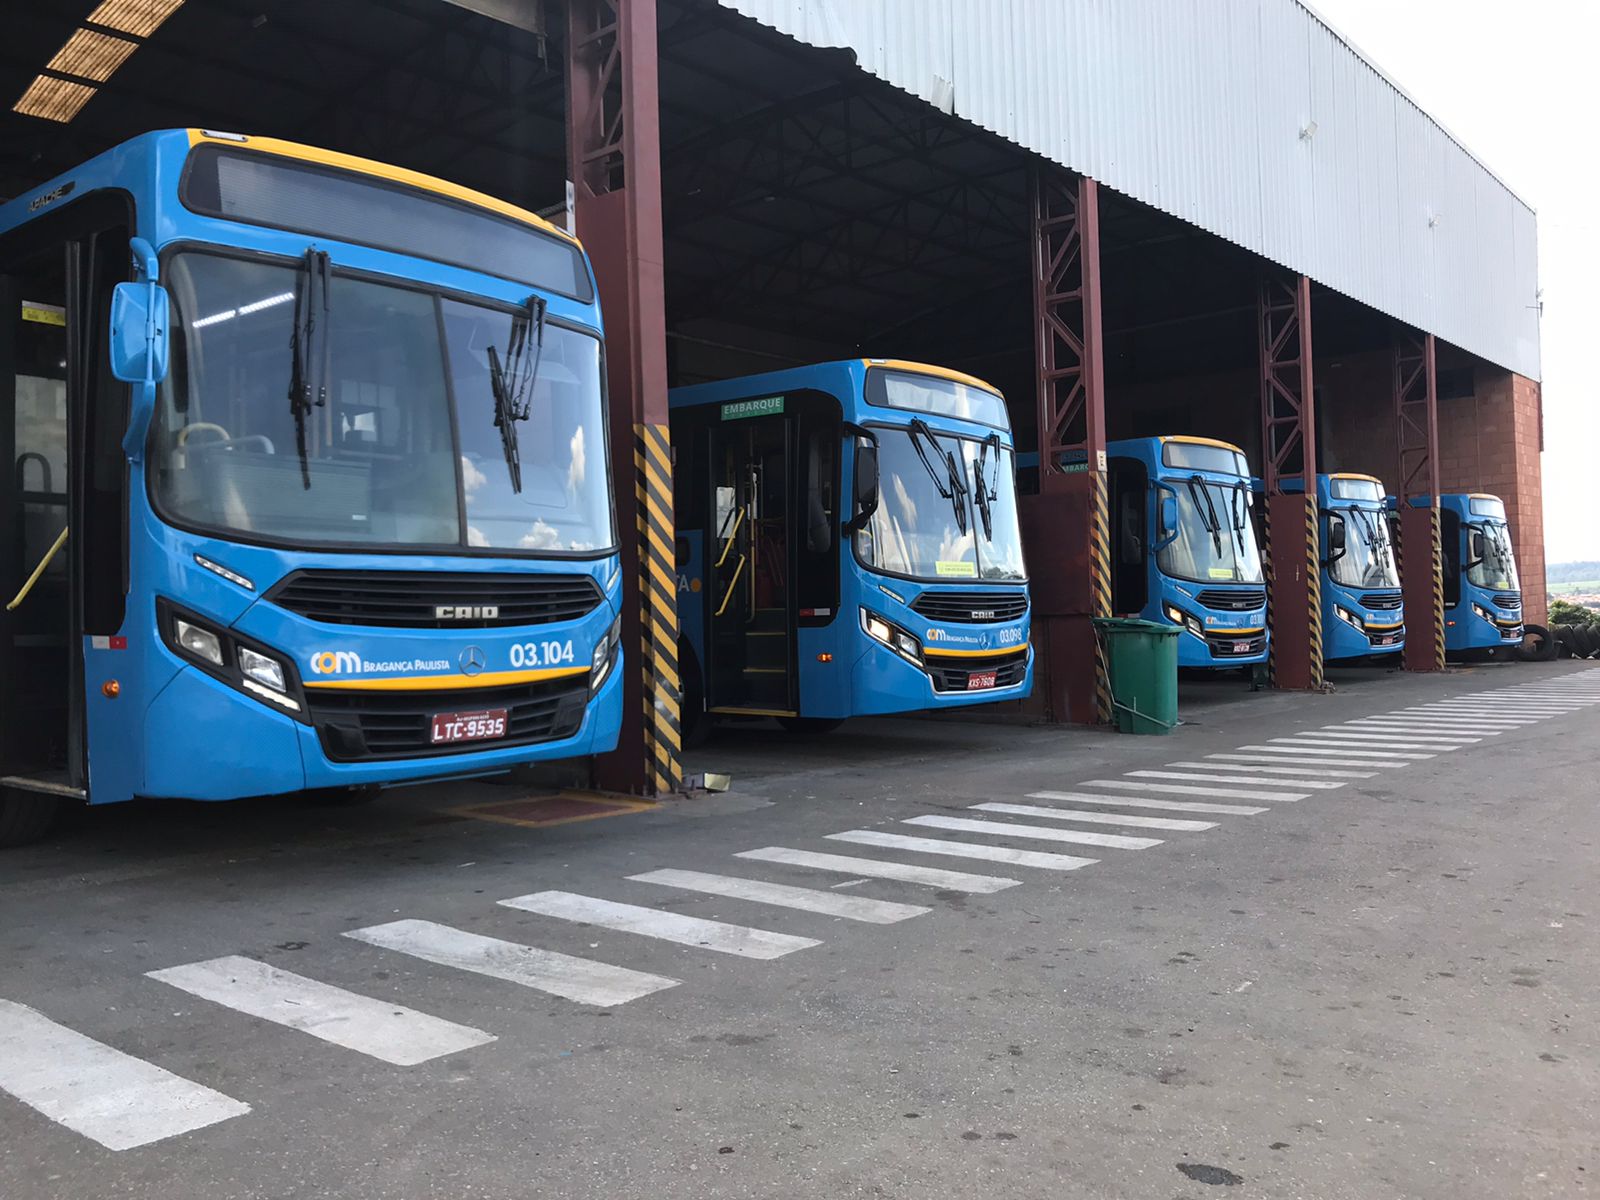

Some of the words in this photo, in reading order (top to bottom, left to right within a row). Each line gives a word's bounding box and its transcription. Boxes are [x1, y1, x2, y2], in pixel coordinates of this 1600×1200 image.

[724, 398, 781, 414] EMBARQUE
[436, 606, 498, 619] CAIO
[510, 639, 575, 668] 03.104
[363, 660, 413, 673] BRAGANÇA
[414, 659, 450, 671] PAULISTA
